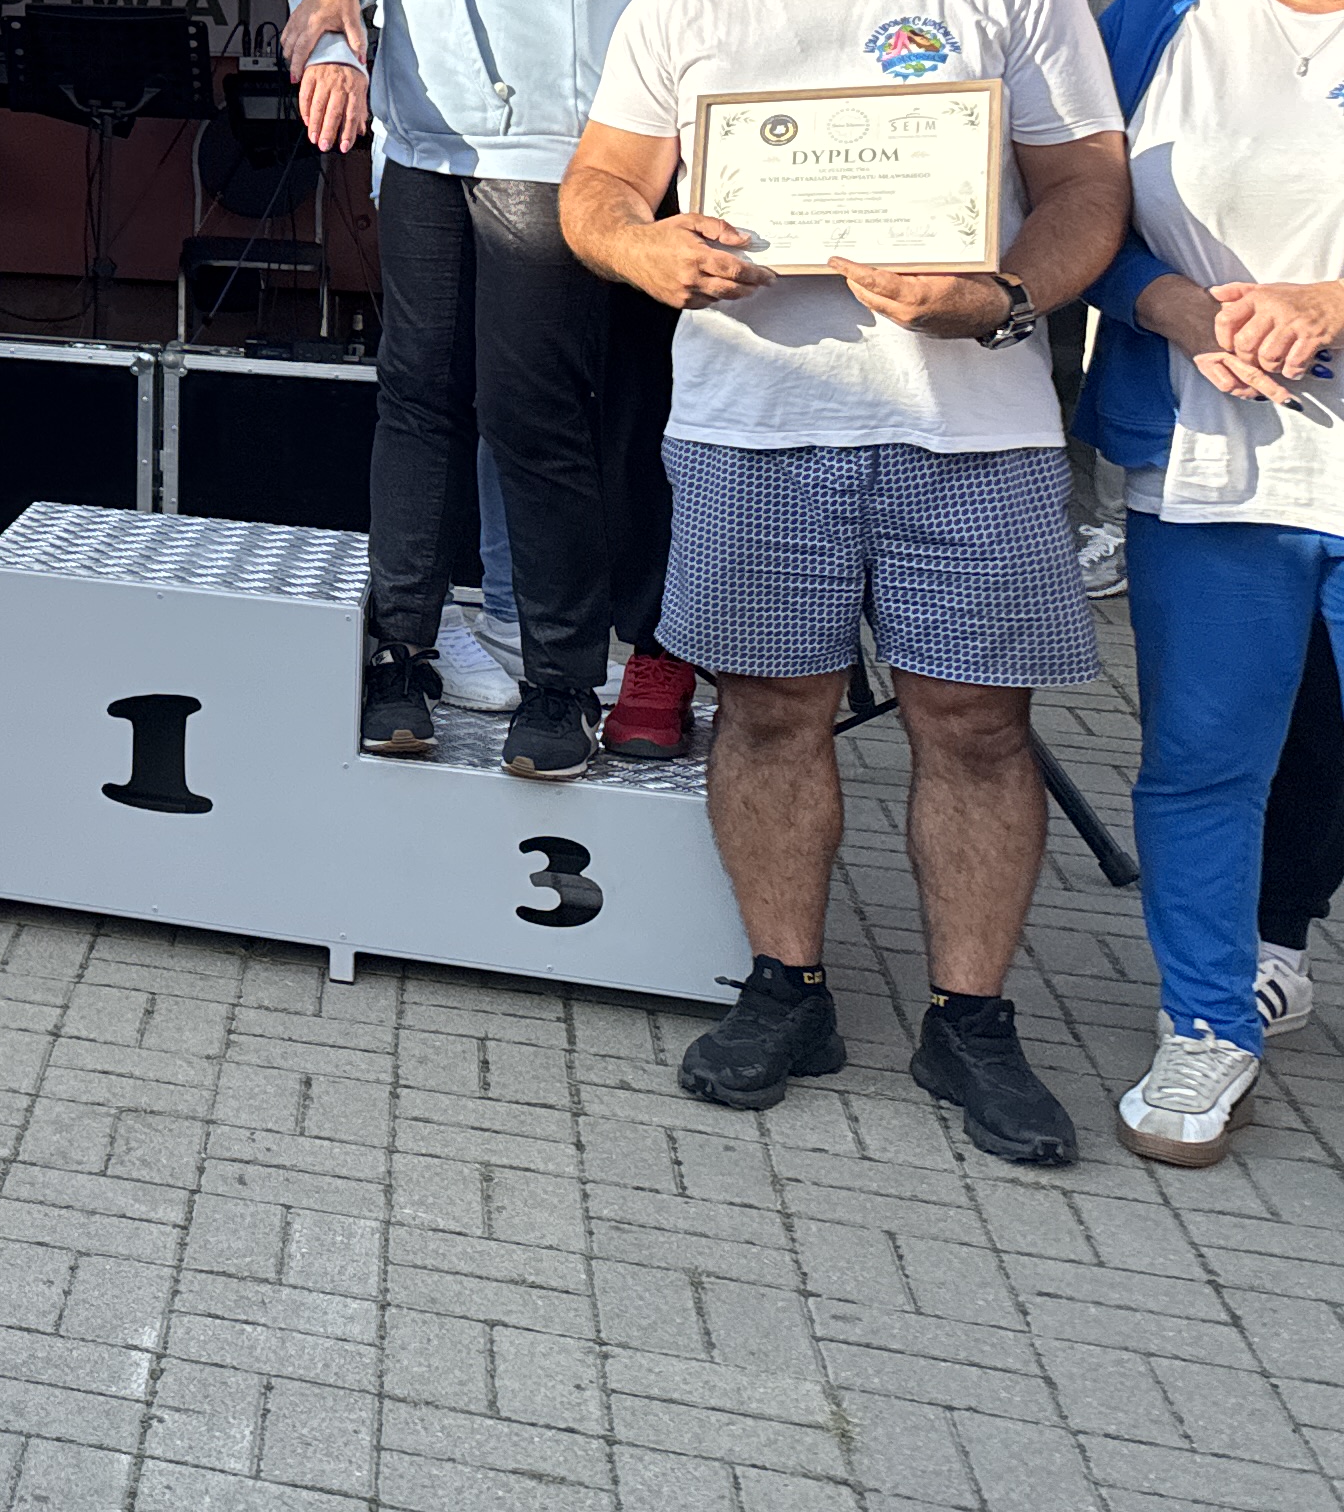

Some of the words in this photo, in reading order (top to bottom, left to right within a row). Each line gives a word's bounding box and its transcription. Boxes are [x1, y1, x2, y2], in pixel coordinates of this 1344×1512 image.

[890, 120, 936, 134] SEJM
[792, 148, 900, 165] DYPLOM
[101, 693, 213, 814] 1
[515, 835, 603, 928] 3
